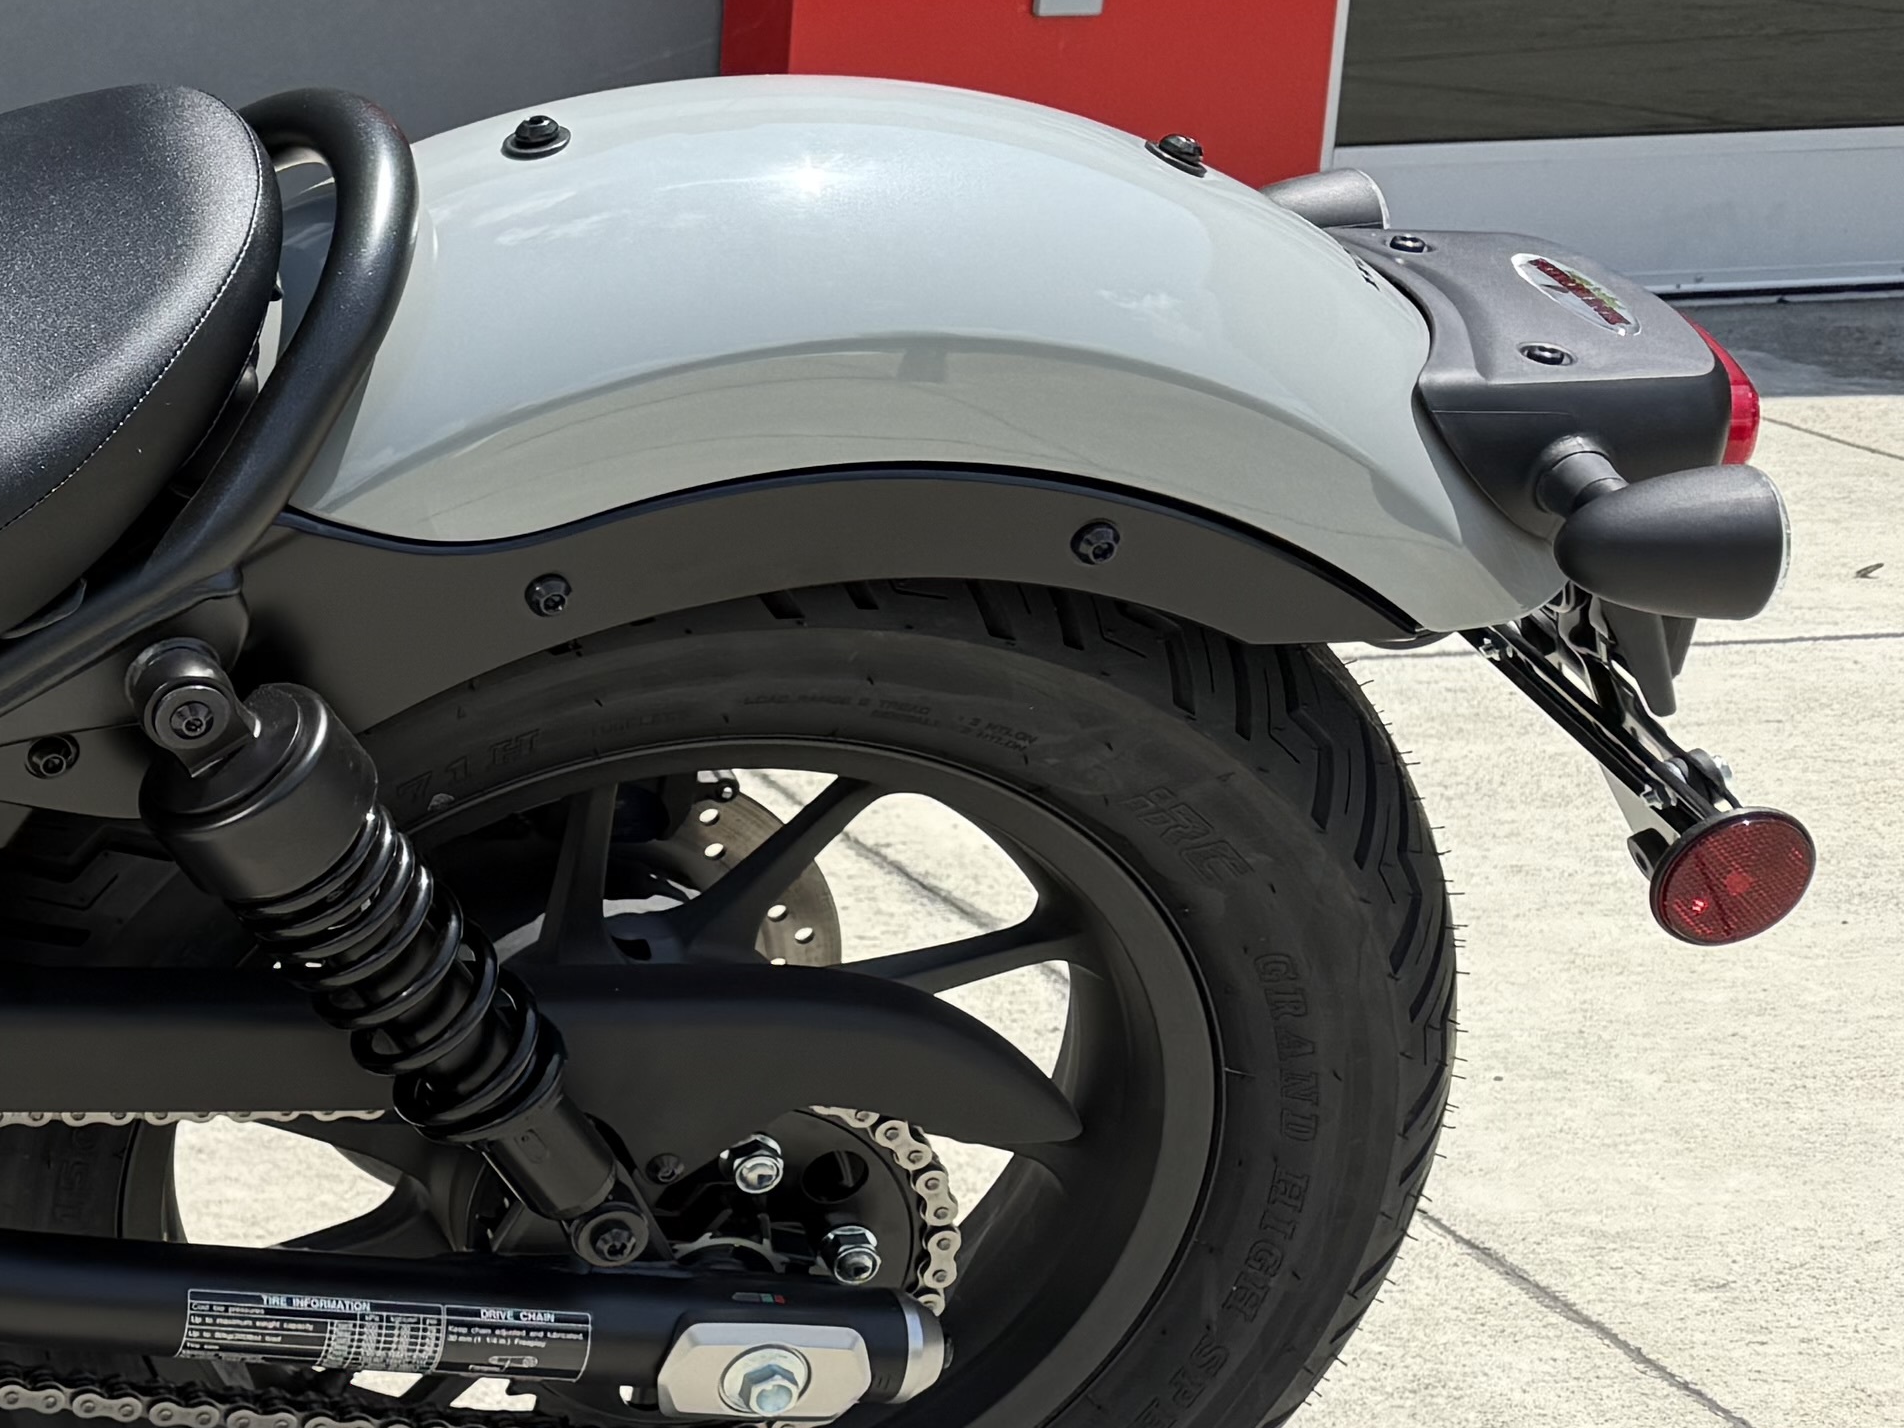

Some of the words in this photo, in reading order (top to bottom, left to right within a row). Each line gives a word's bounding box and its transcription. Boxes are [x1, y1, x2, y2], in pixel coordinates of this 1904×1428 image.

[1252, 951, 1322, 1143] GRAND
[1222, 1162, 1311, 1324] HIGH
[260, 1293, 287, 1307] TIRE
[292, 1295, 371, 1312] INFORMATION
[480, 1309, 514, 1322] DRIVE
[519, 1311, 555, 1323] CHAIN
